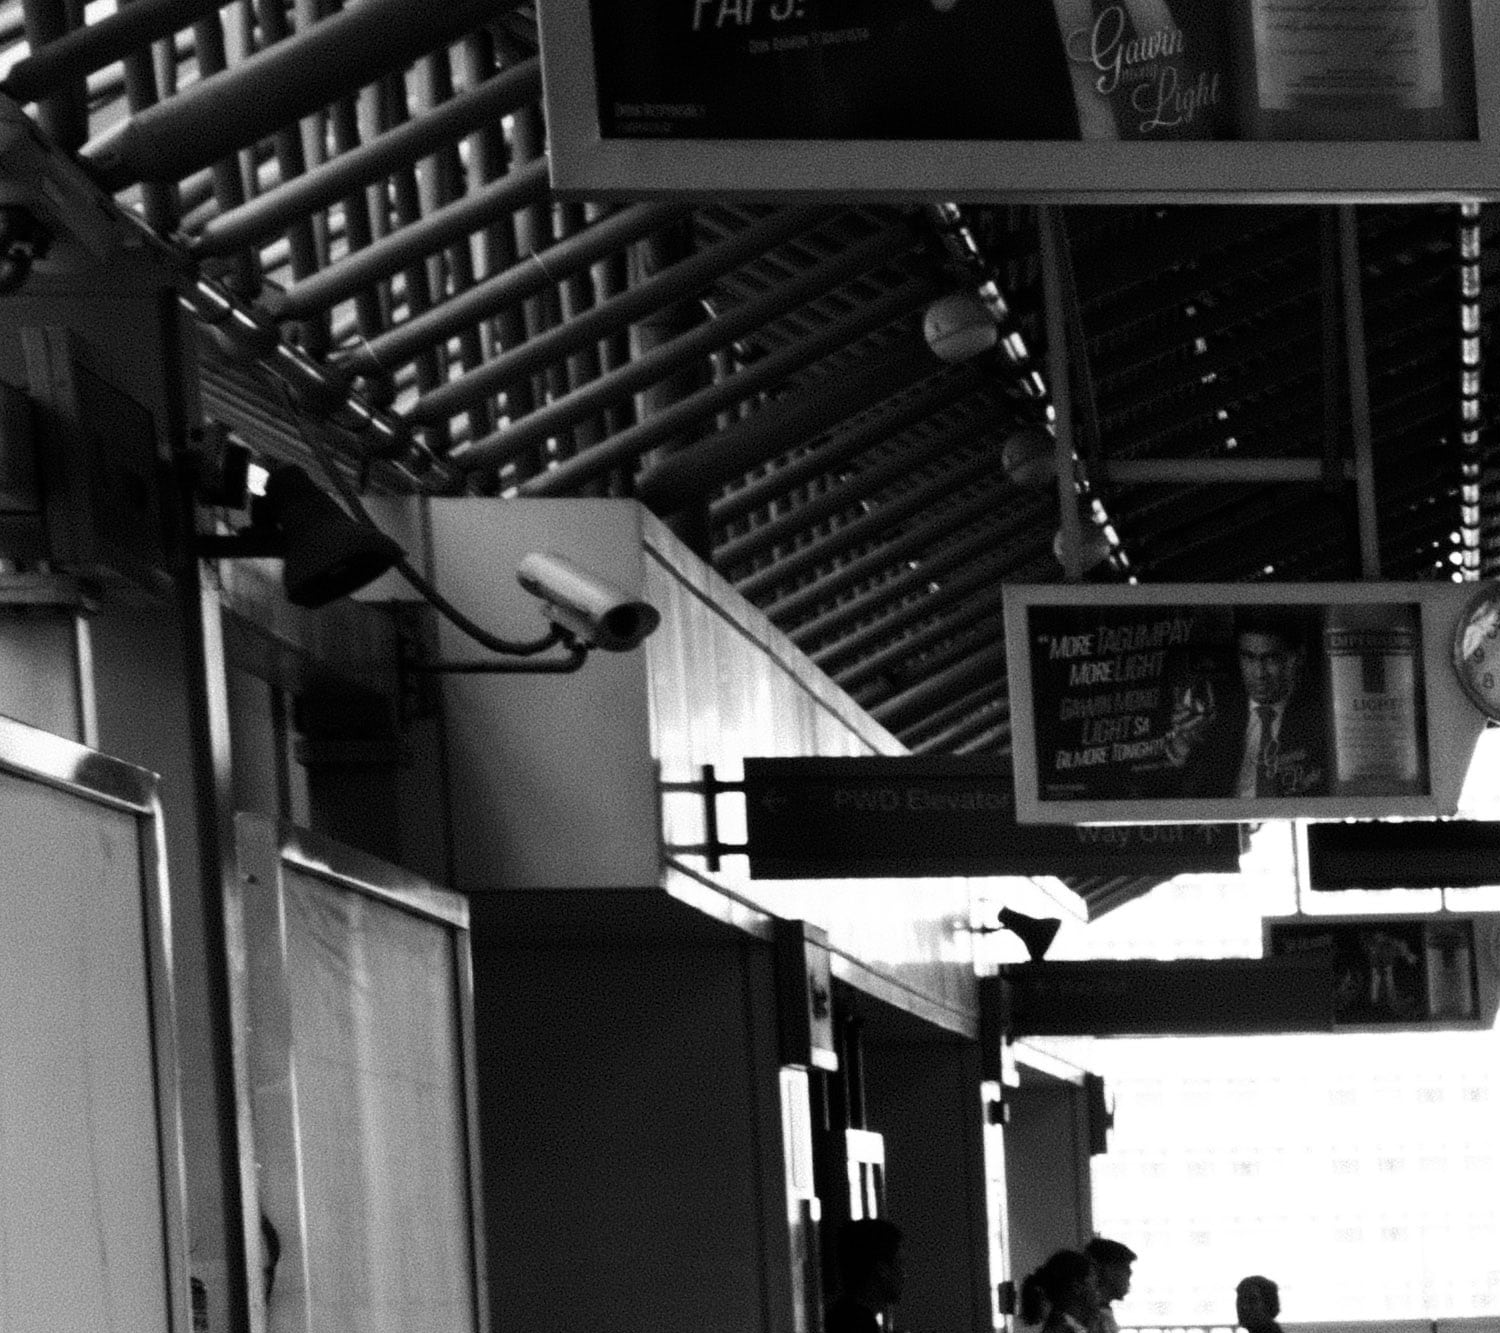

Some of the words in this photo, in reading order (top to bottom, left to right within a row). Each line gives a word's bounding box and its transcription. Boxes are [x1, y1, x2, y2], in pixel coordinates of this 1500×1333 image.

[1066, 6, 1184, 94] Gawin
[1132, 66, 1219, 132] Light
[1069, 660, 1112, 687] MORE
[1113, 650, 1167, 682] LIGHT
[834, 790, 897, 809] PWD
[908, 789, 1011, 809] Elevator
